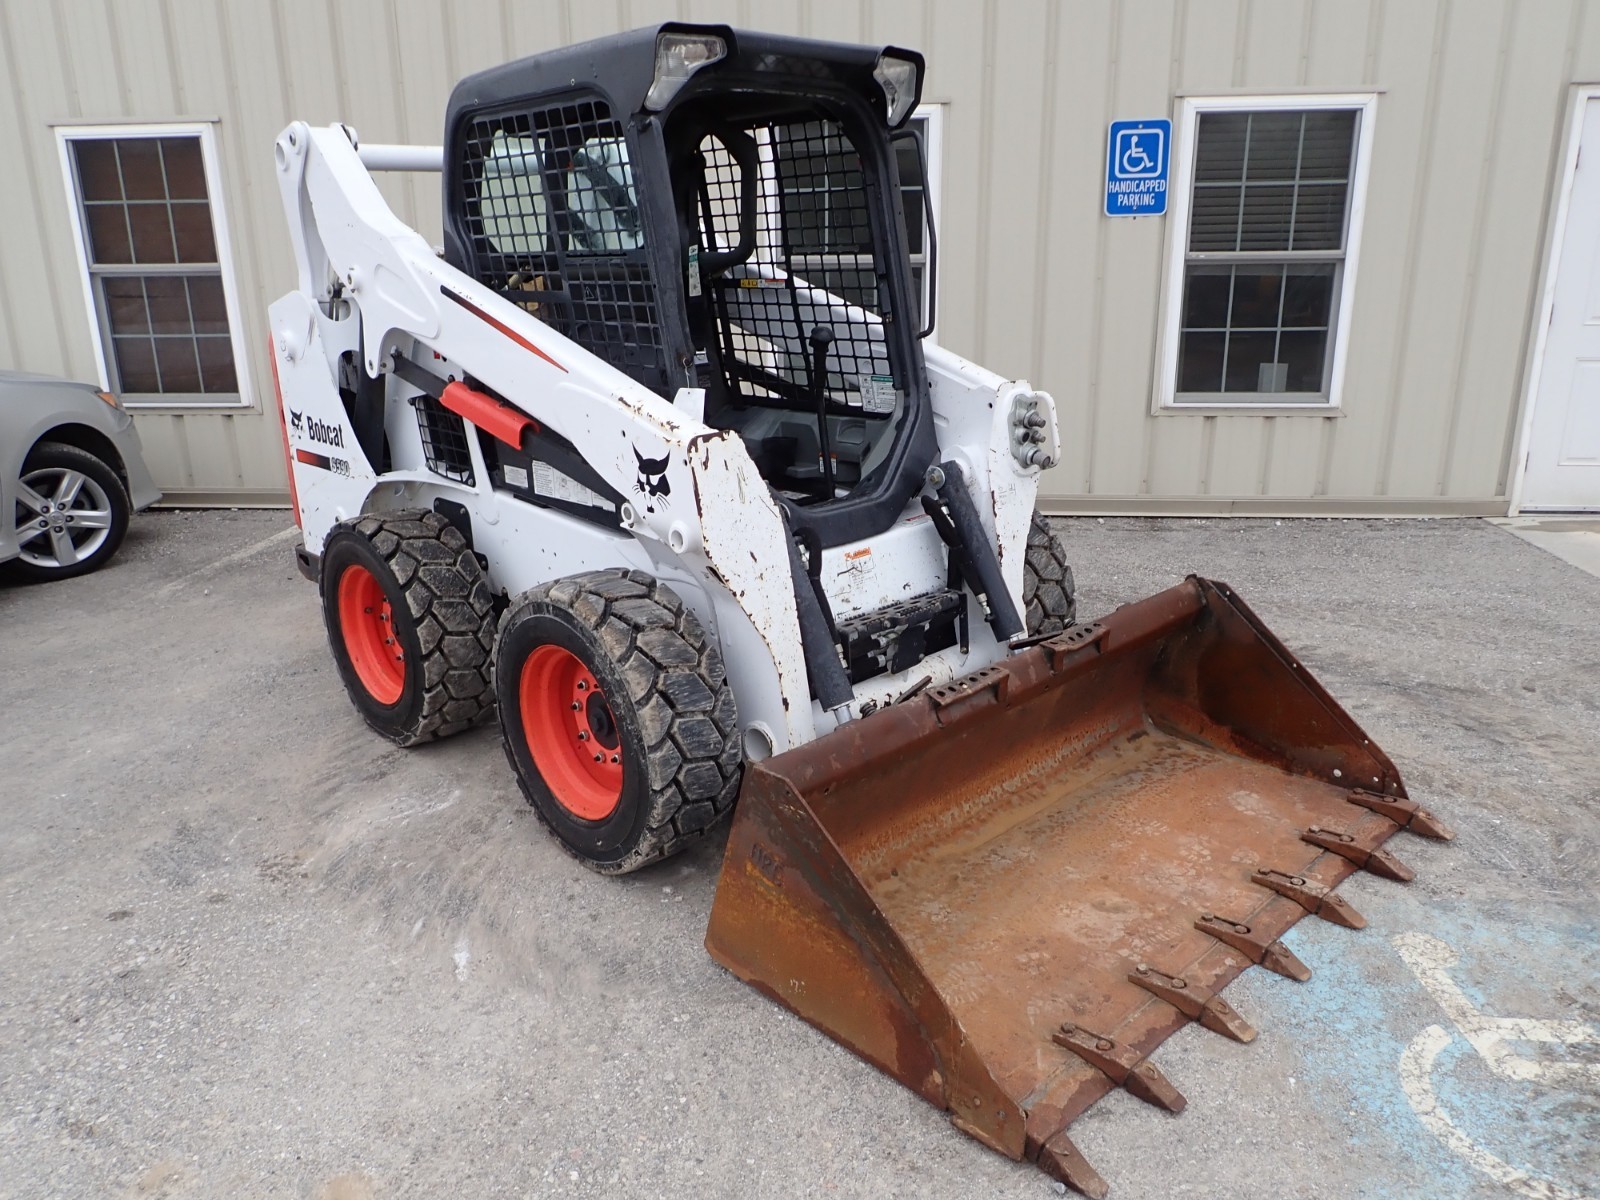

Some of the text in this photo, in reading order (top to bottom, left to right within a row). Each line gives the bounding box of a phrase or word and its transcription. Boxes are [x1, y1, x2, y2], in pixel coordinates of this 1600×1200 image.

[1109, 180, 1165, 193] HANDICAPPED
[1117, 193, 1155, 206] PARKING
[306, 415, 345, 449] Bobcat
[331, 457, 350, 477] S590
